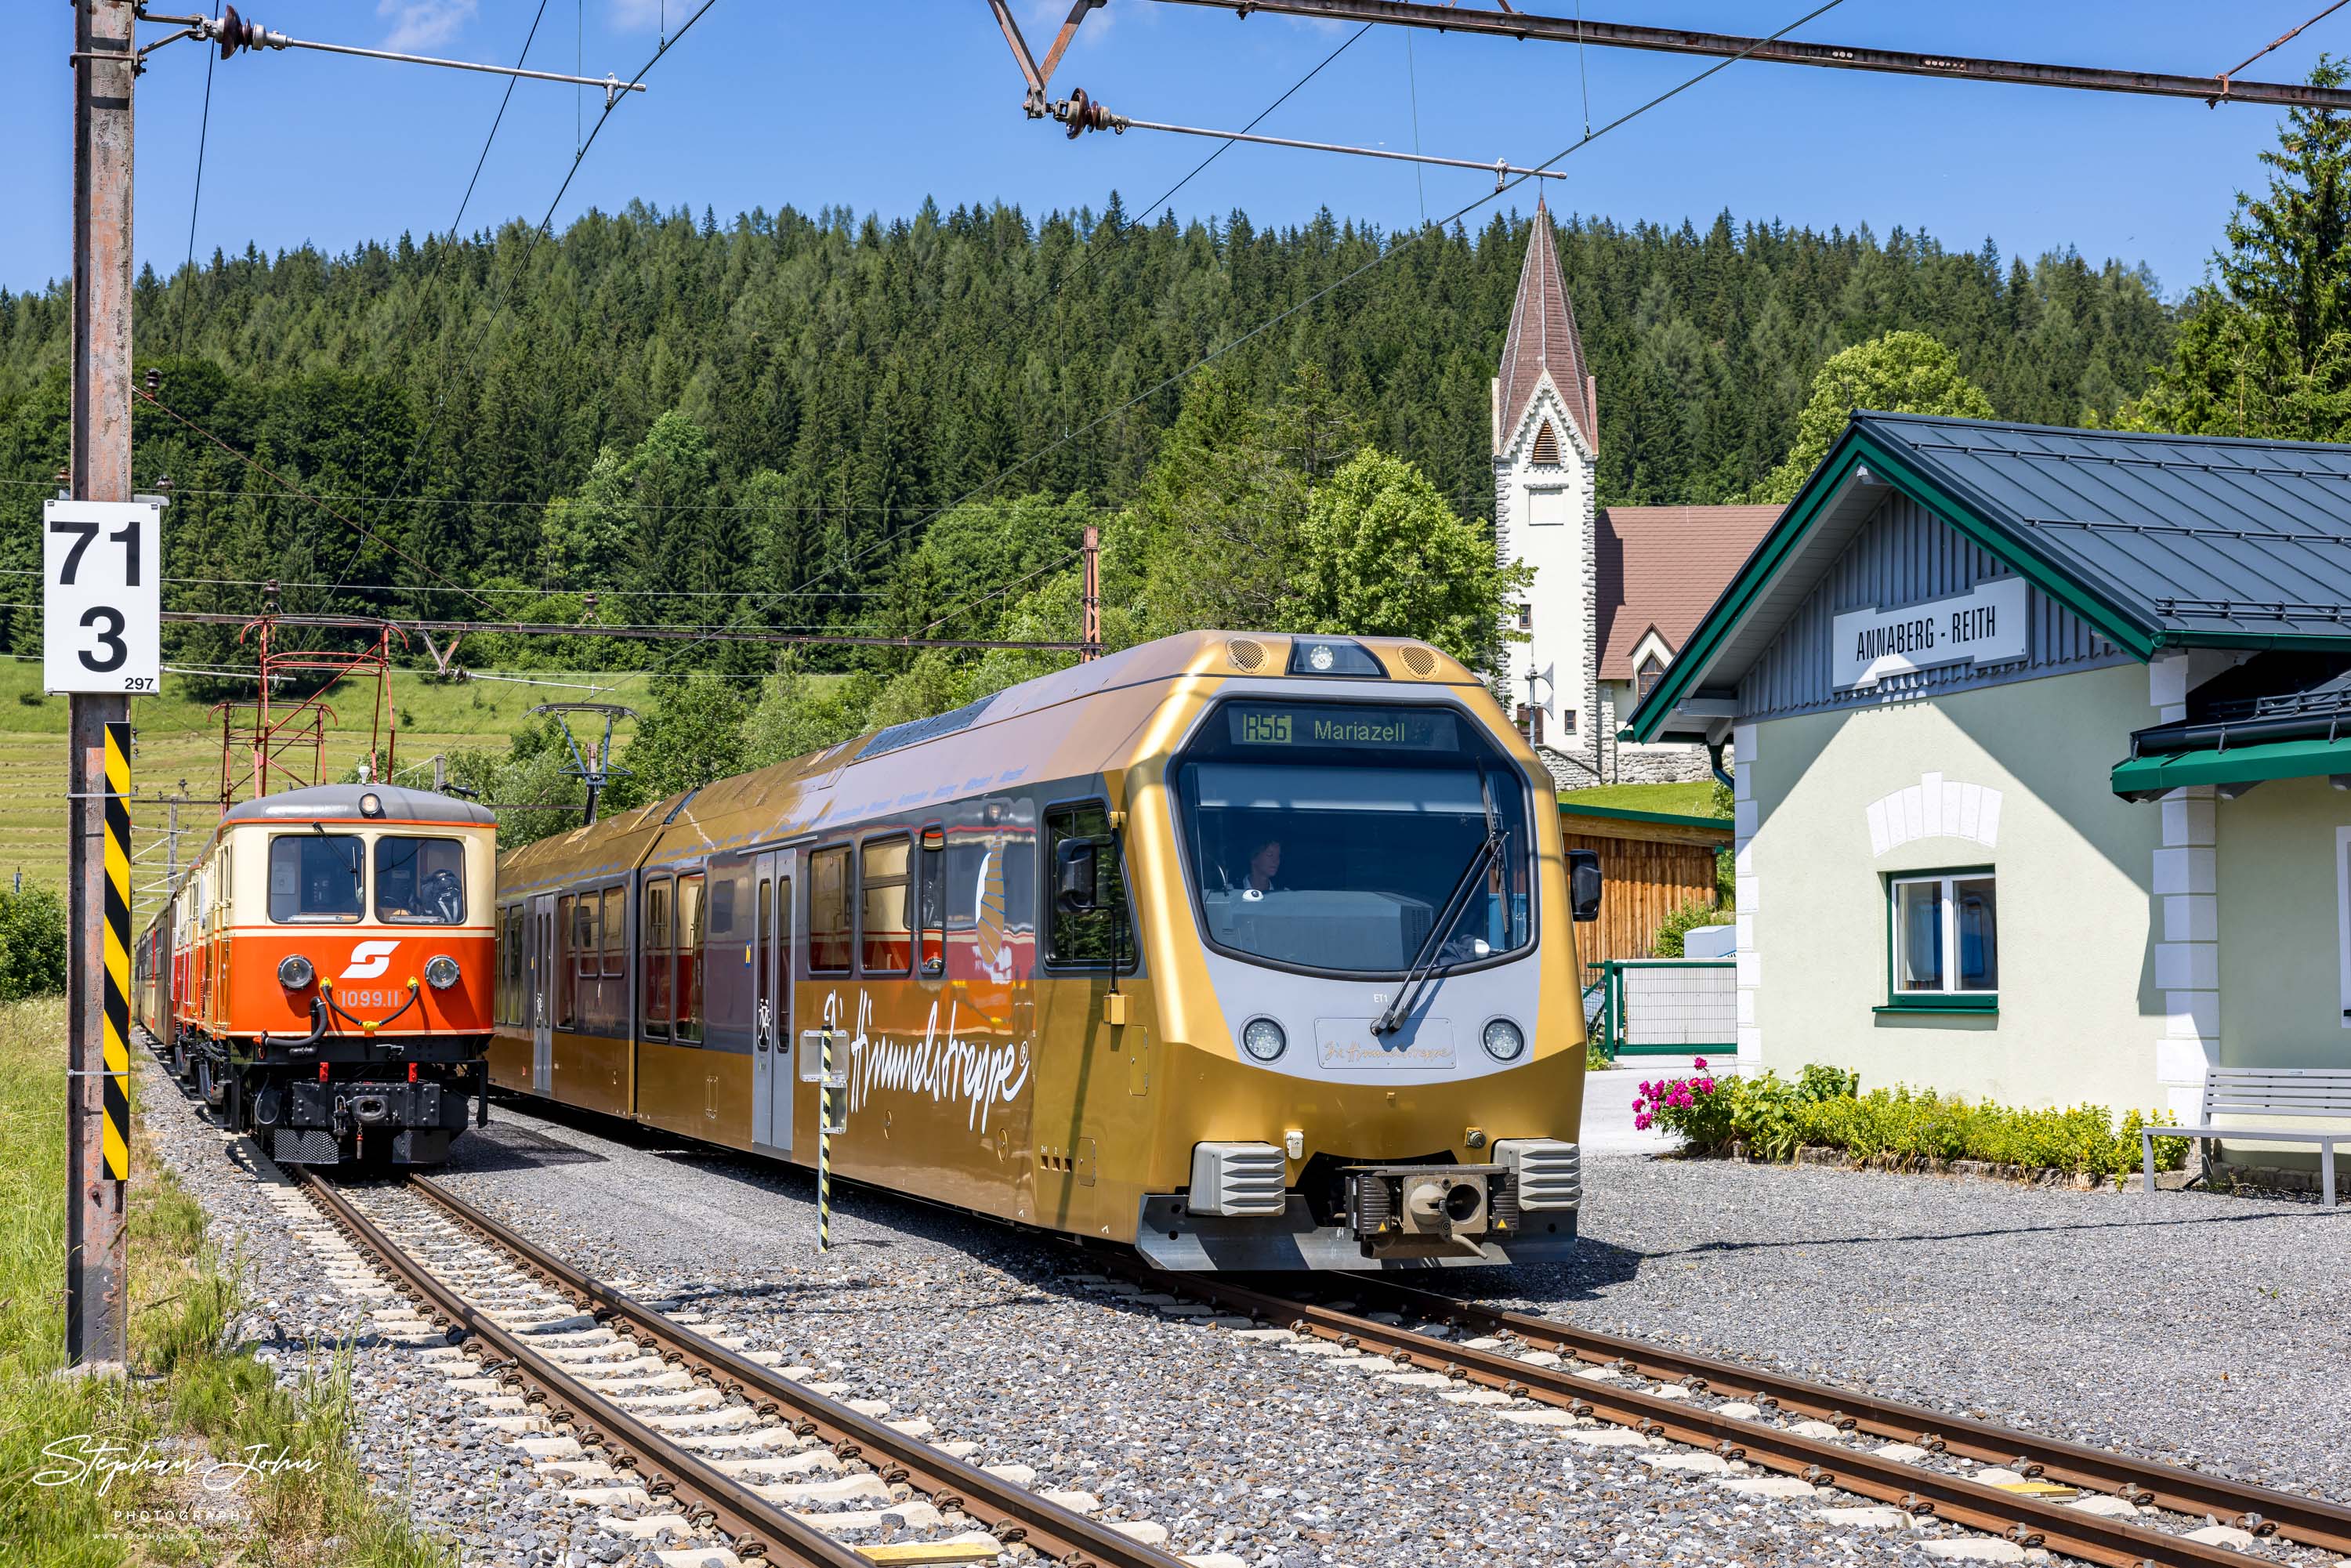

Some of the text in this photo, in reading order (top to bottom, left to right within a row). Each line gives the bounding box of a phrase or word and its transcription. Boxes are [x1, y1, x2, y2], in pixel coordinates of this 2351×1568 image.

[50, 521, 140, 586] 71
[78, 606, 128, 672] 3
[1857, 617, 1934, 661] ANNABERG
[1951, 606, 1995, 643] REITH
[125, 677, 154, 690] 297
[1246, 714, 1405, 741] R56 Mariazell
[342, 990, 399, 1007] 1099.11
[1373, 994, 1388, 1003] ET1
